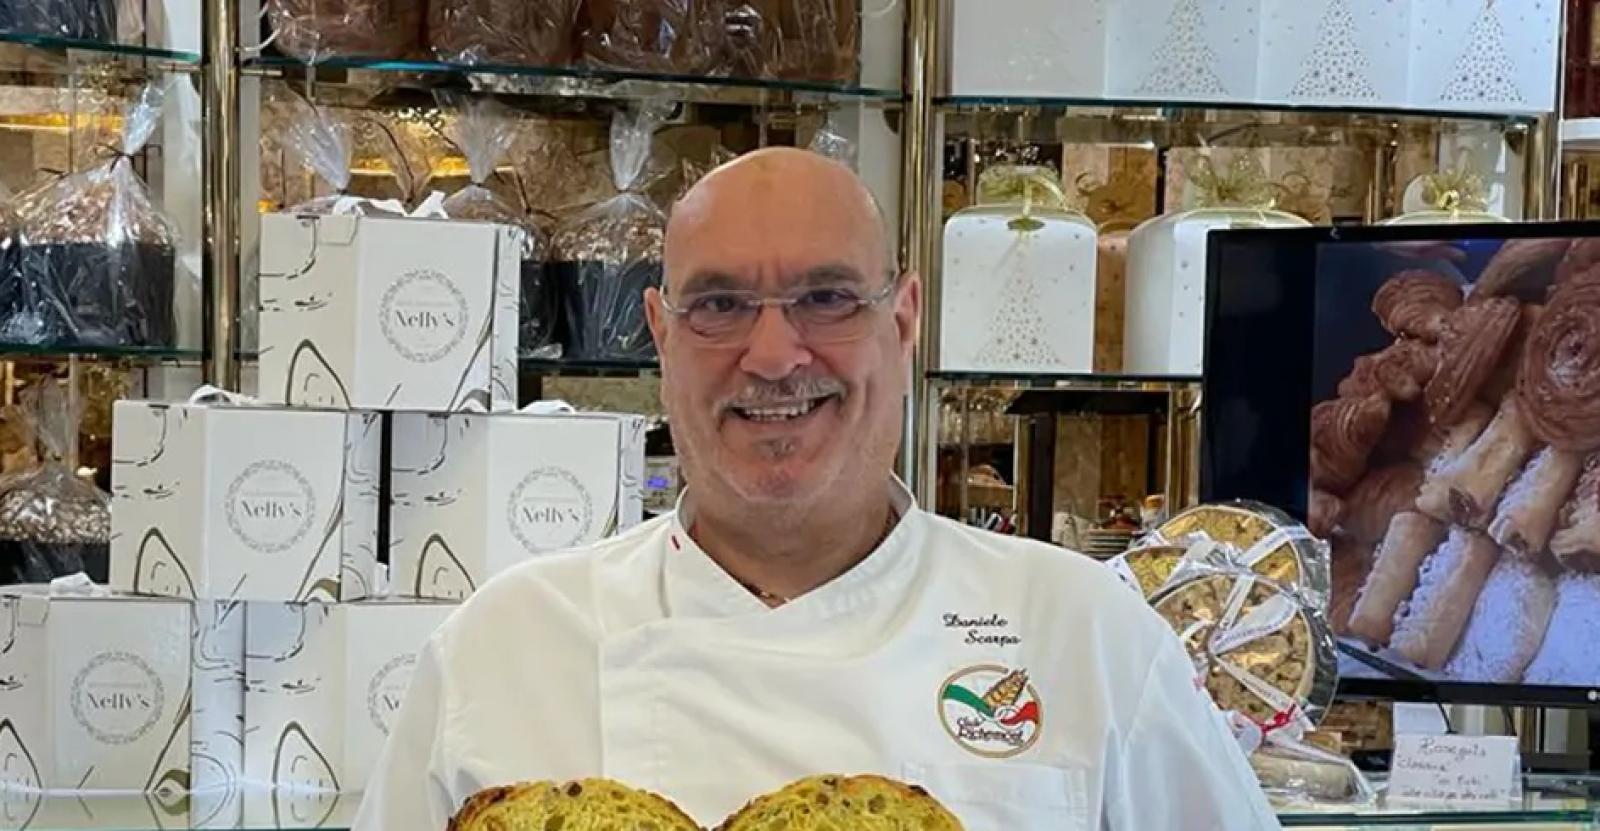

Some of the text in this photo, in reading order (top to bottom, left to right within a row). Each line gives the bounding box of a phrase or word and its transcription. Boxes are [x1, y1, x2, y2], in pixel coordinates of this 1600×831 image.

[395, 309, 456, 330] Nelly's
[240, 499, 302, 520] Nelly's
[521, 505, 580, 525] Nelly's
[964, 629, 1021, 646] Scarpa
[86, 691, 150, 712] Nelly's
